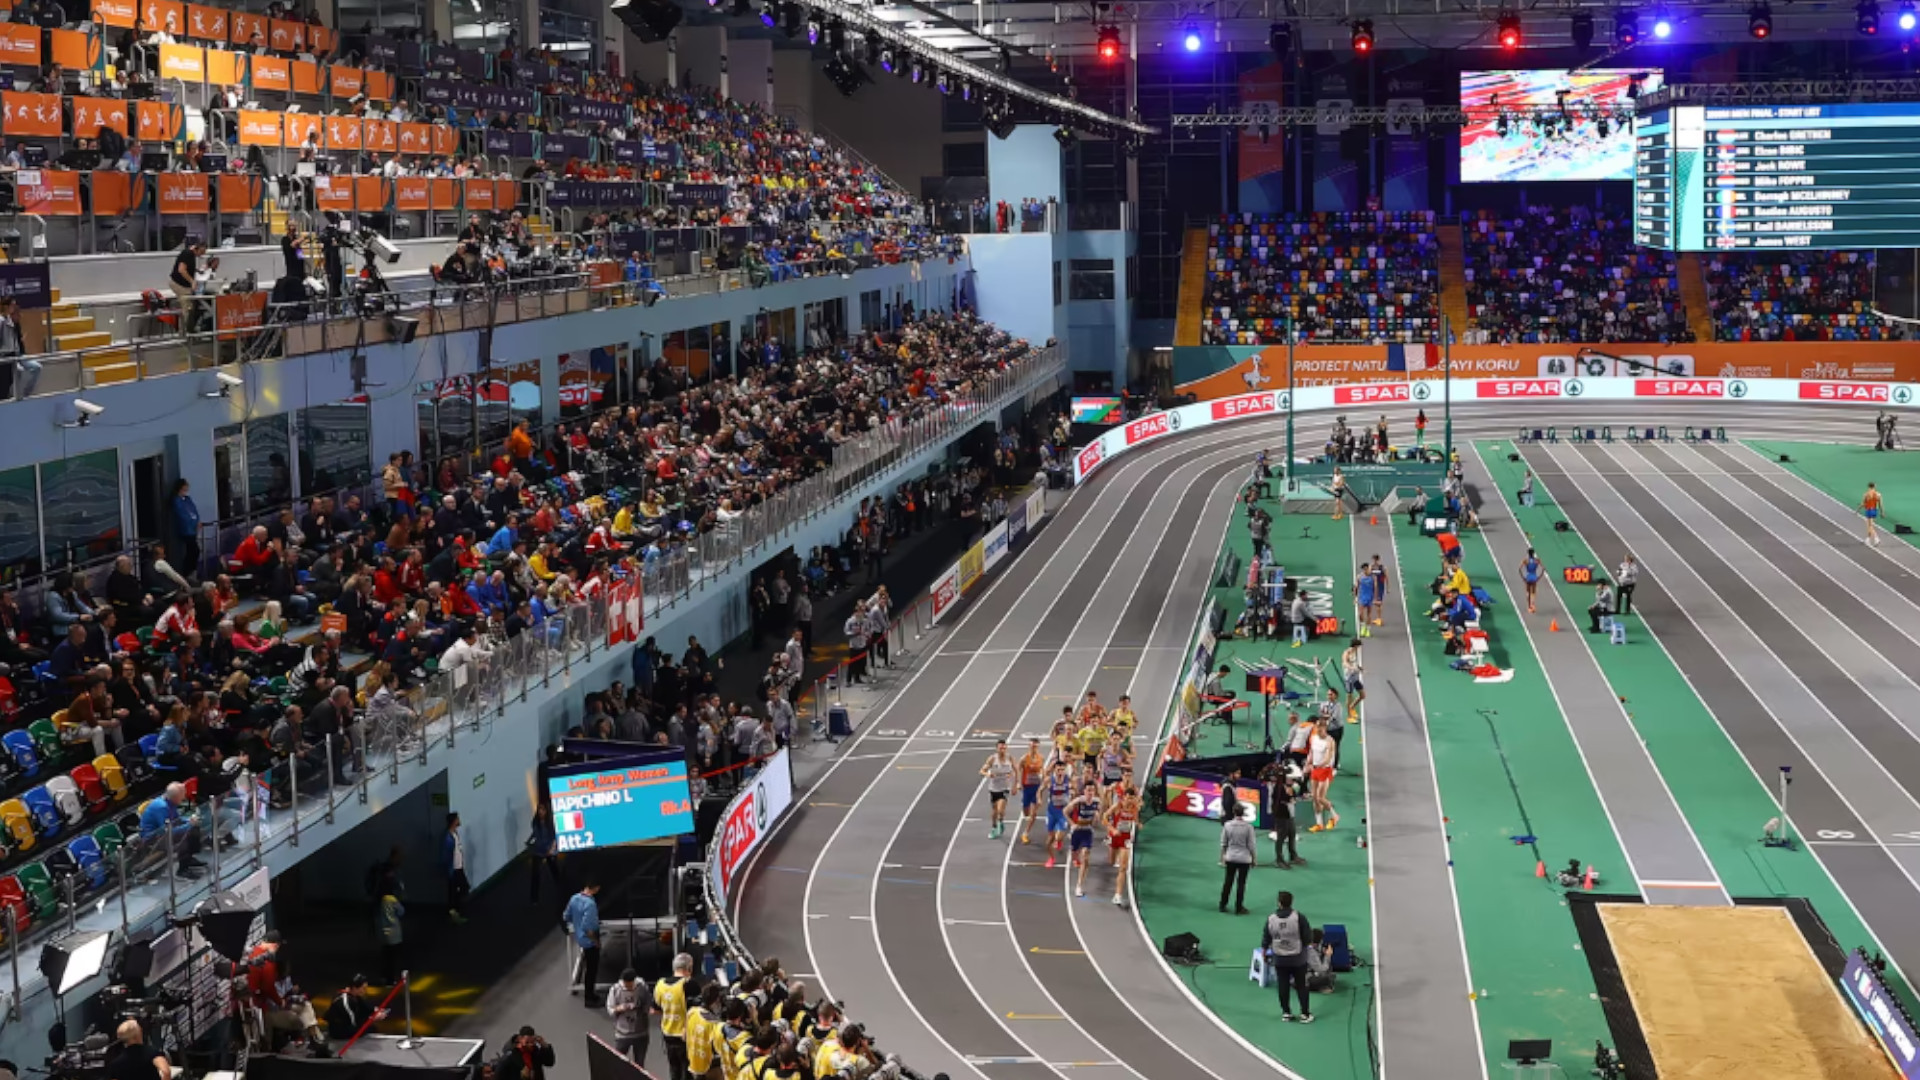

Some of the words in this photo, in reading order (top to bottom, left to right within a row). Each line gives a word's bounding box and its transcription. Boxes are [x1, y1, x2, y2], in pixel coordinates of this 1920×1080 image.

[1293, 360, 1350, 372] PROTECT
[1476, 360, 1520, 371] KORU
[1350, 386, 1409, 401] SPAR
[1495, 380, 1560, 396] SPAR
[1654, 380, 1723, 396] SPAR
[1819, 385, 1888, 400] SPAR
[1224, 395, 1274, 415] SPAR
[1133, 415, 1168, 440] SPAR
[1565, 568, 1590, 583] 1:00
[1260, 676, 1277, 695] 14
[568, 779, 597, 790] Long
[627, 768, 669, 780] Women
[623, 788, 634, 803] L
[558, 831, 595, 852] Att.2
[1816, 829, 1856, 839] 8
